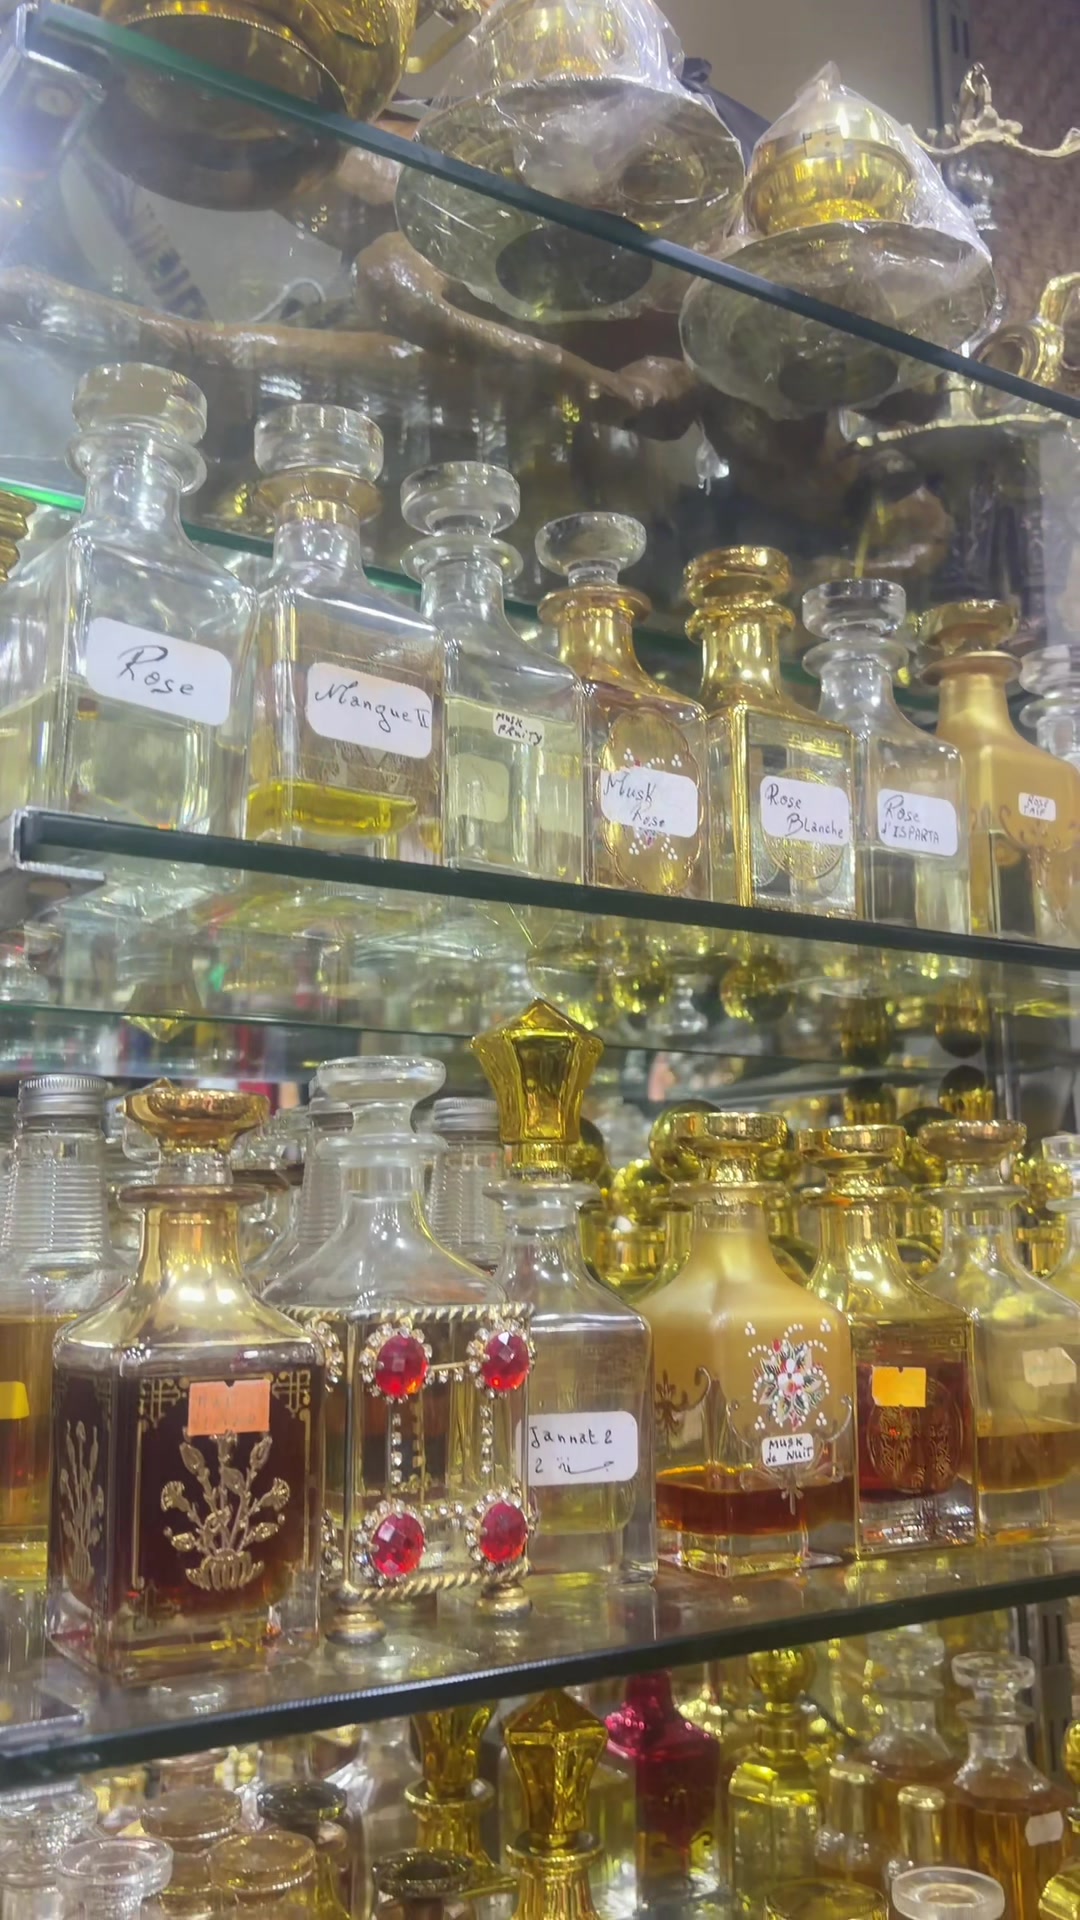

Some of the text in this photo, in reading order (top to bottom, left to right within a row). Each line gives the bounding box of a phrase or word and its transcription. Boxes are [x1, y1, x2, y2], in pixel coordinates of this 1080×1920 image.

[117, 644, 194, 696] Rose
[314, 680, 412, 733] Mangue
[603, 771, 656, 802] Musk
[764, 782, 802, 810] Rose
[630, 801, 666, 828] Rose
[883, 794, 920, 823] Rose
[530, 1426, 613, 1449] Jannat 2
